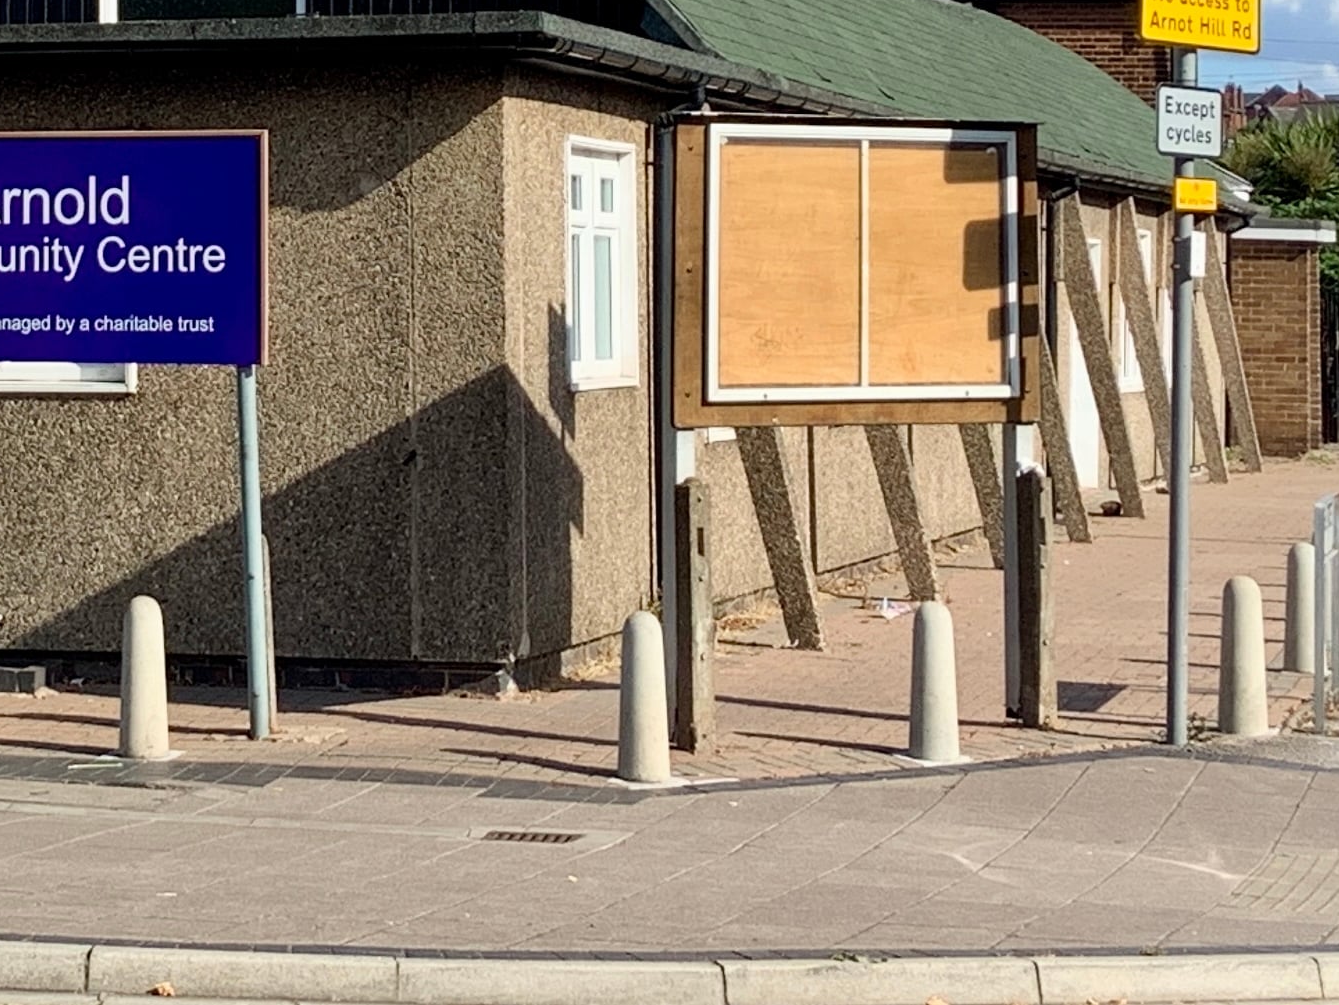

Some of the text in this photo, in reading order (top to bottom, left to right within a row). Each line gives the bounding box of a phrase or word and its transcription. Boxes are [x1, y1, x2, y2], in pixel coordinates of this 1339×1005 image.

[1150, 10, 1252, 40] Arnot Hill Rd
[1165, 95, 1215, 120] Except
[1166, 124, 1212, 145] cycles
[96, 235, 226, 273] Centre
[55, 314, 75, 336] by
[79, 318, 90, 332] a
[94, 314, 173, 332] charitable
[177, 315, 215, 333] trust
